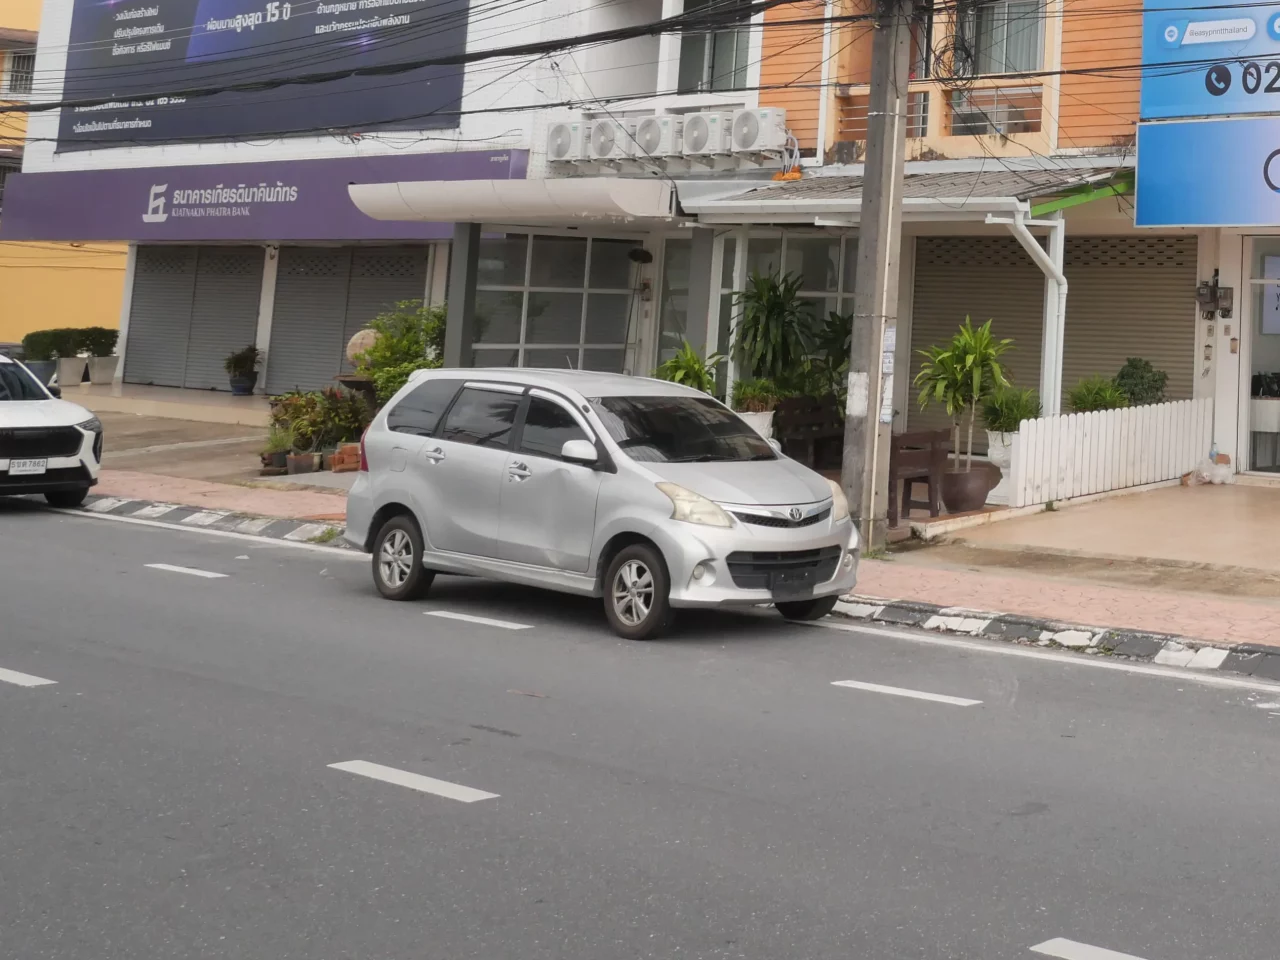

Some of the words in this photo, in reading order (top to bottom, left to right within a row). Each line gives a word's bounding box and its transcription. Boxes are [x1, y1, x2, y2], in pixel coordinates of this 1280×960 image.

[266, 1, 280, 23] 15
[172, 180, 299, 206] ธนาคารเกียรตินาคินภัทร
[171, 207, 206, 218] KIATNAKIN
[206, 206, 232, 217] PHATRA
[233, 206, 250, 217] BANK
